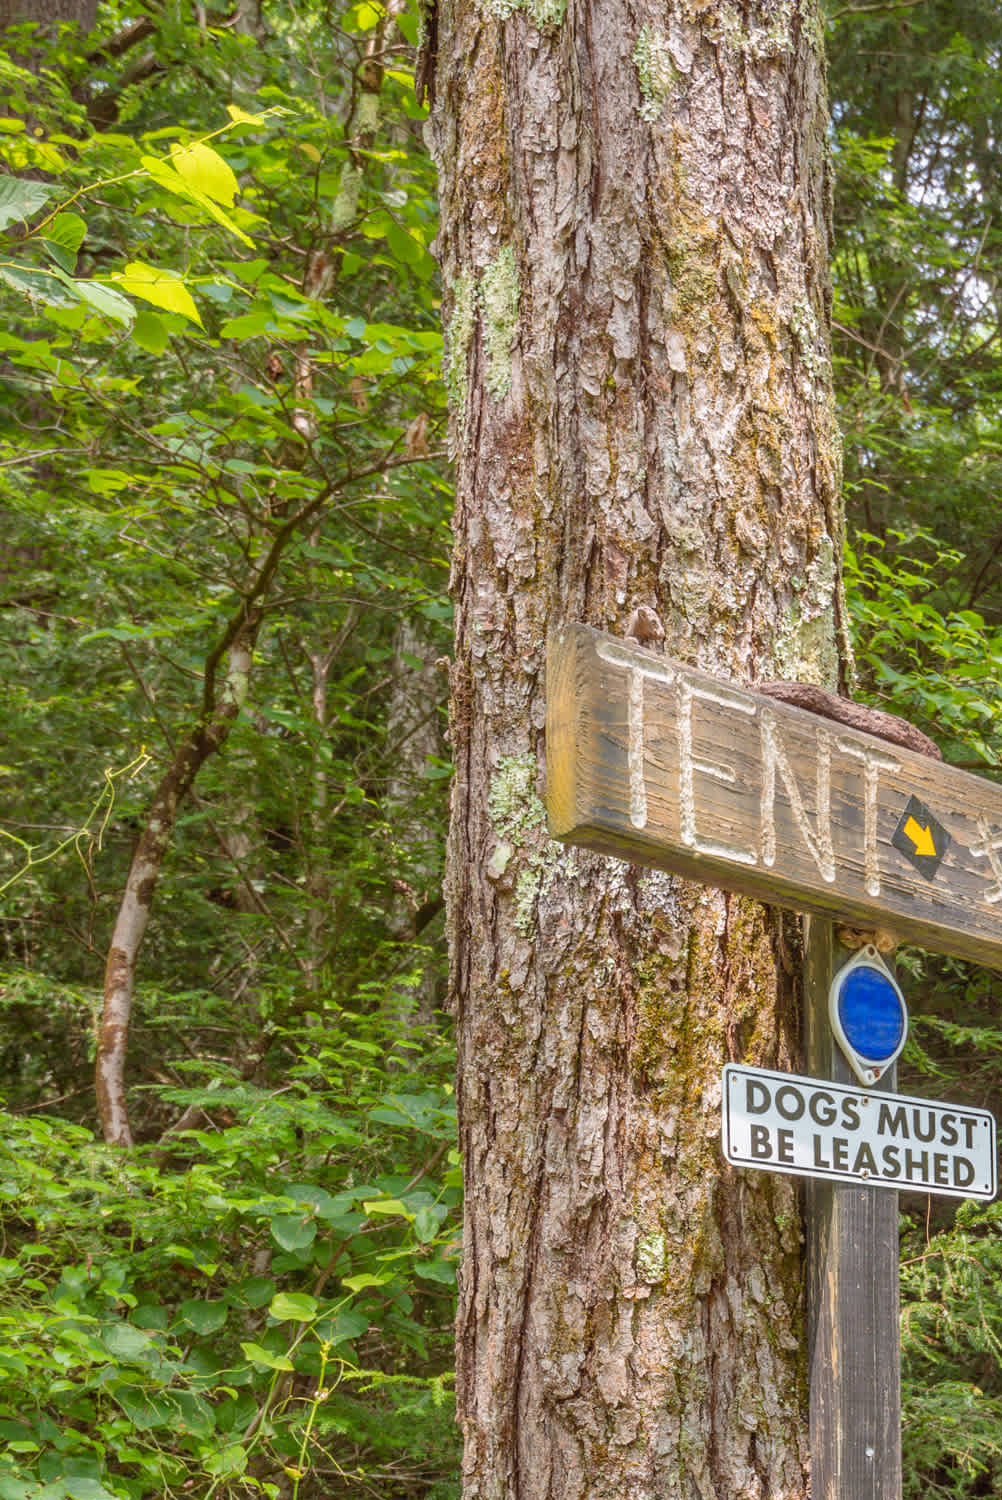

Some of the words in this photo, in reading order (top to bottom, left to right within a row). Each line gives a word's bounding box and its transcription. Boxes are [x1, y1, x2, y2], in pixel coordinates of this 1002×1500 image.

[597, 640, 901, 897] TENT
[746, 1079, 861, 1131] DOGS
[877, 1103, 978, 1149] MUST
[750, 1124, 795, 1164] BE
[813, 1134, 976, 1187] LEASHED
